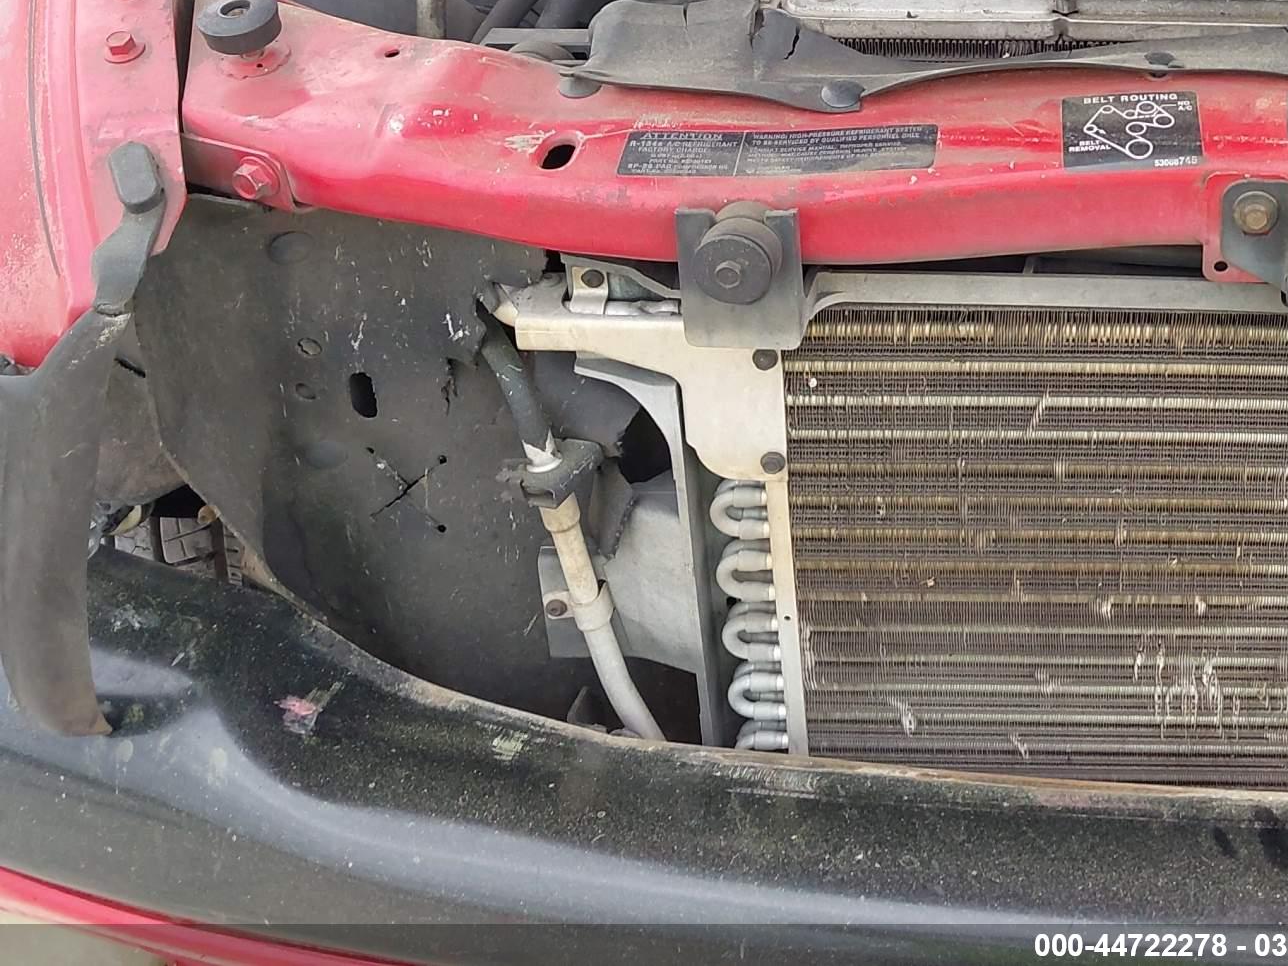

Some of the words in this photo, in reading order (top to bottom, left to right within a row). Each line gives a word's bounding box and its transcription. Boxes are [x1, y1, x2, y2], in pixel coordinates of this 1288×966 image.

[1083, 95, 1115, 104] BELT
[1120, 93, 1178, 103] ROUTING
[1068, 145, 1111, 153] REMOVAL
